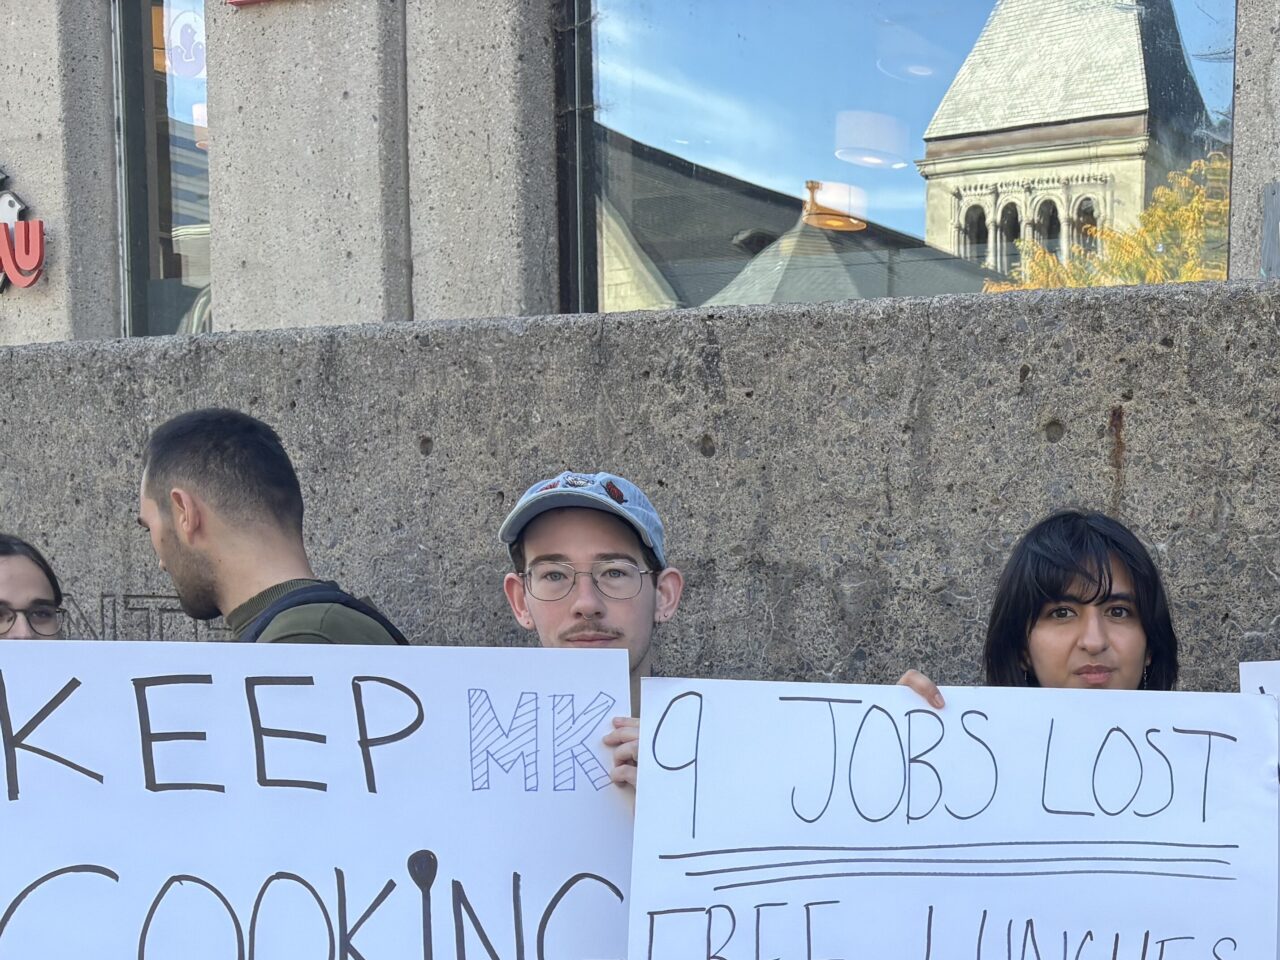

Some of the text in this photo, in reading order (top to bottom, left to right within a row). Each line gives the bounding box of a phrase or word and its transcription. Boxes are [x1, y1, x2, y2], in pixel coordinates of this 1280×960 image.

[0, 669, 618, 801] KEEP MK
[651, 690, 1238, 839] 9 JOBS LOST
